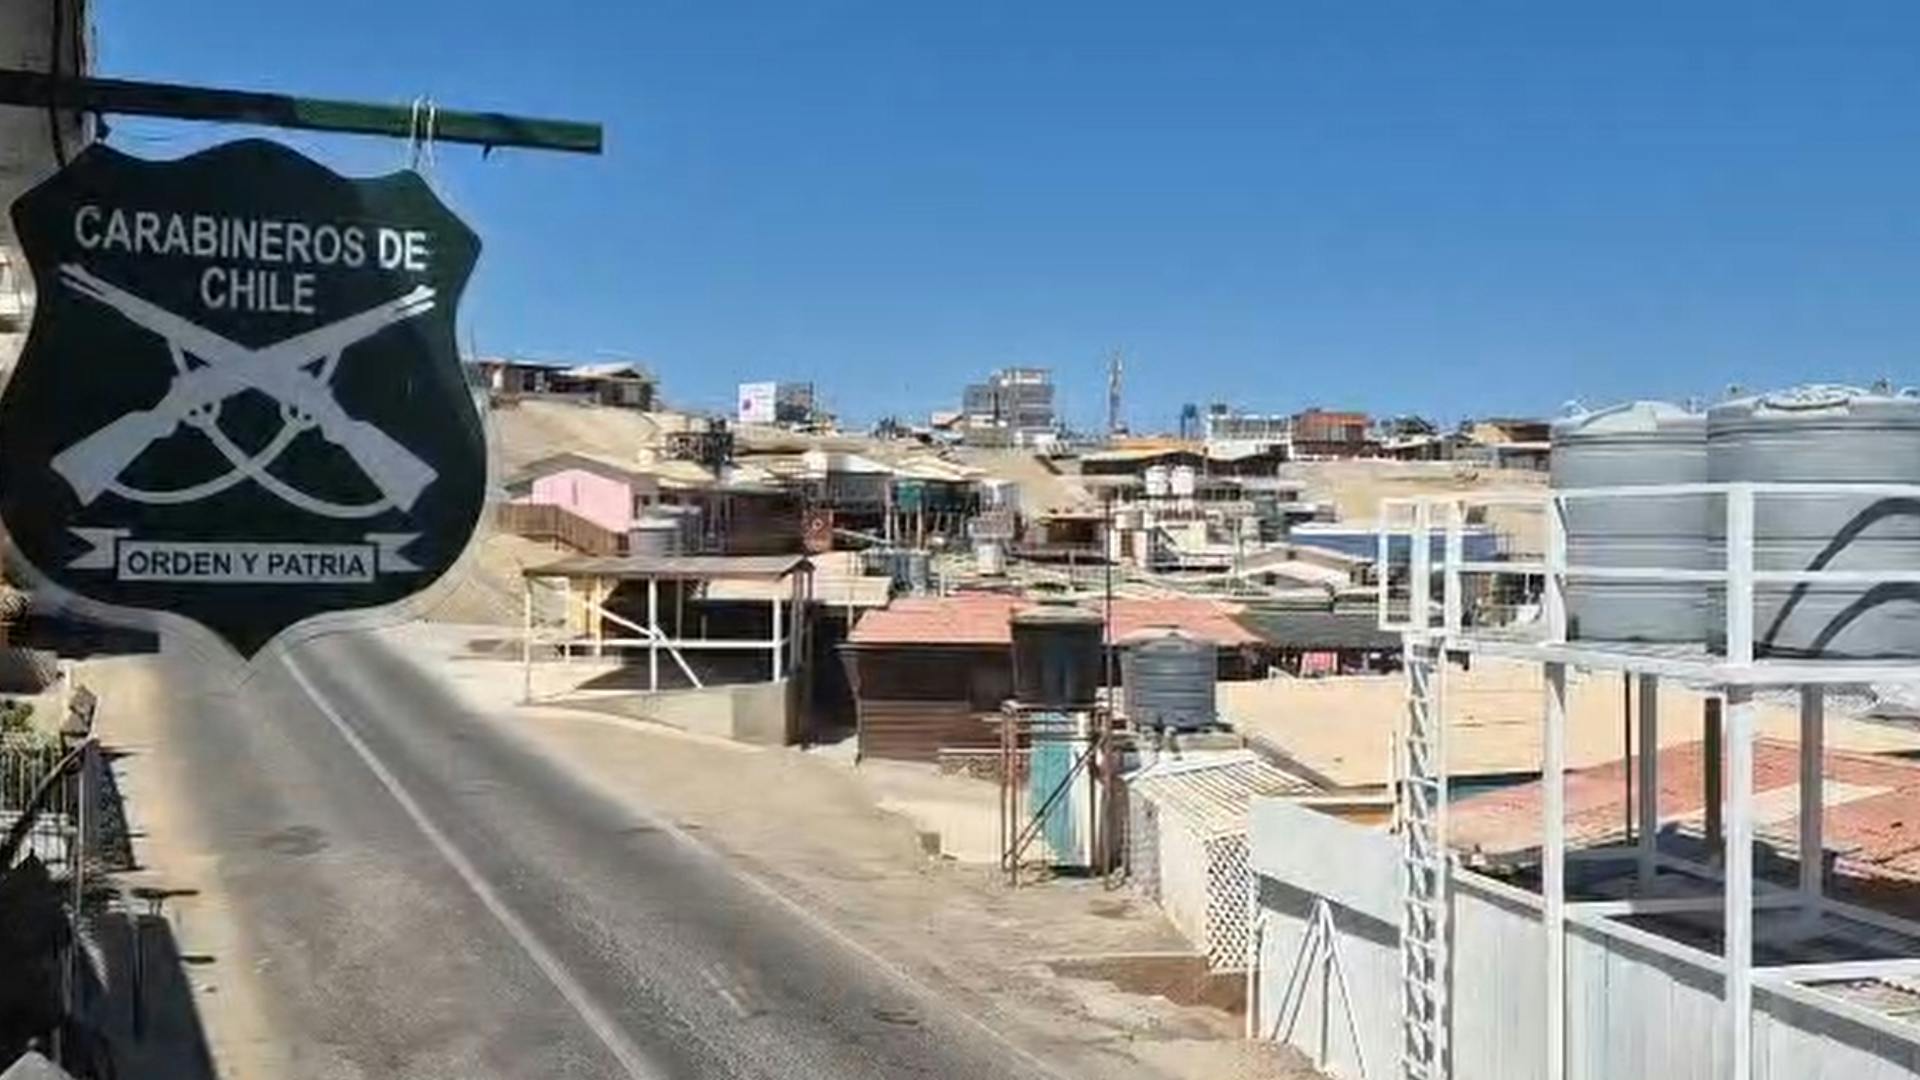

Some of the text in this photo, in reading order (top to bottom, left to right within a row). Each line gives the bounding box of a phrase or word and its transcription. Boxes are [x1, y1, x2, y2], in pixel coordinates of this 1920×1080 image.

[75, 206, 428, 271] CARABINEROS DE
[200, 266, 317, 314] CHILE
[127, 551, 367, 576] ORDEN Y PATRIA
